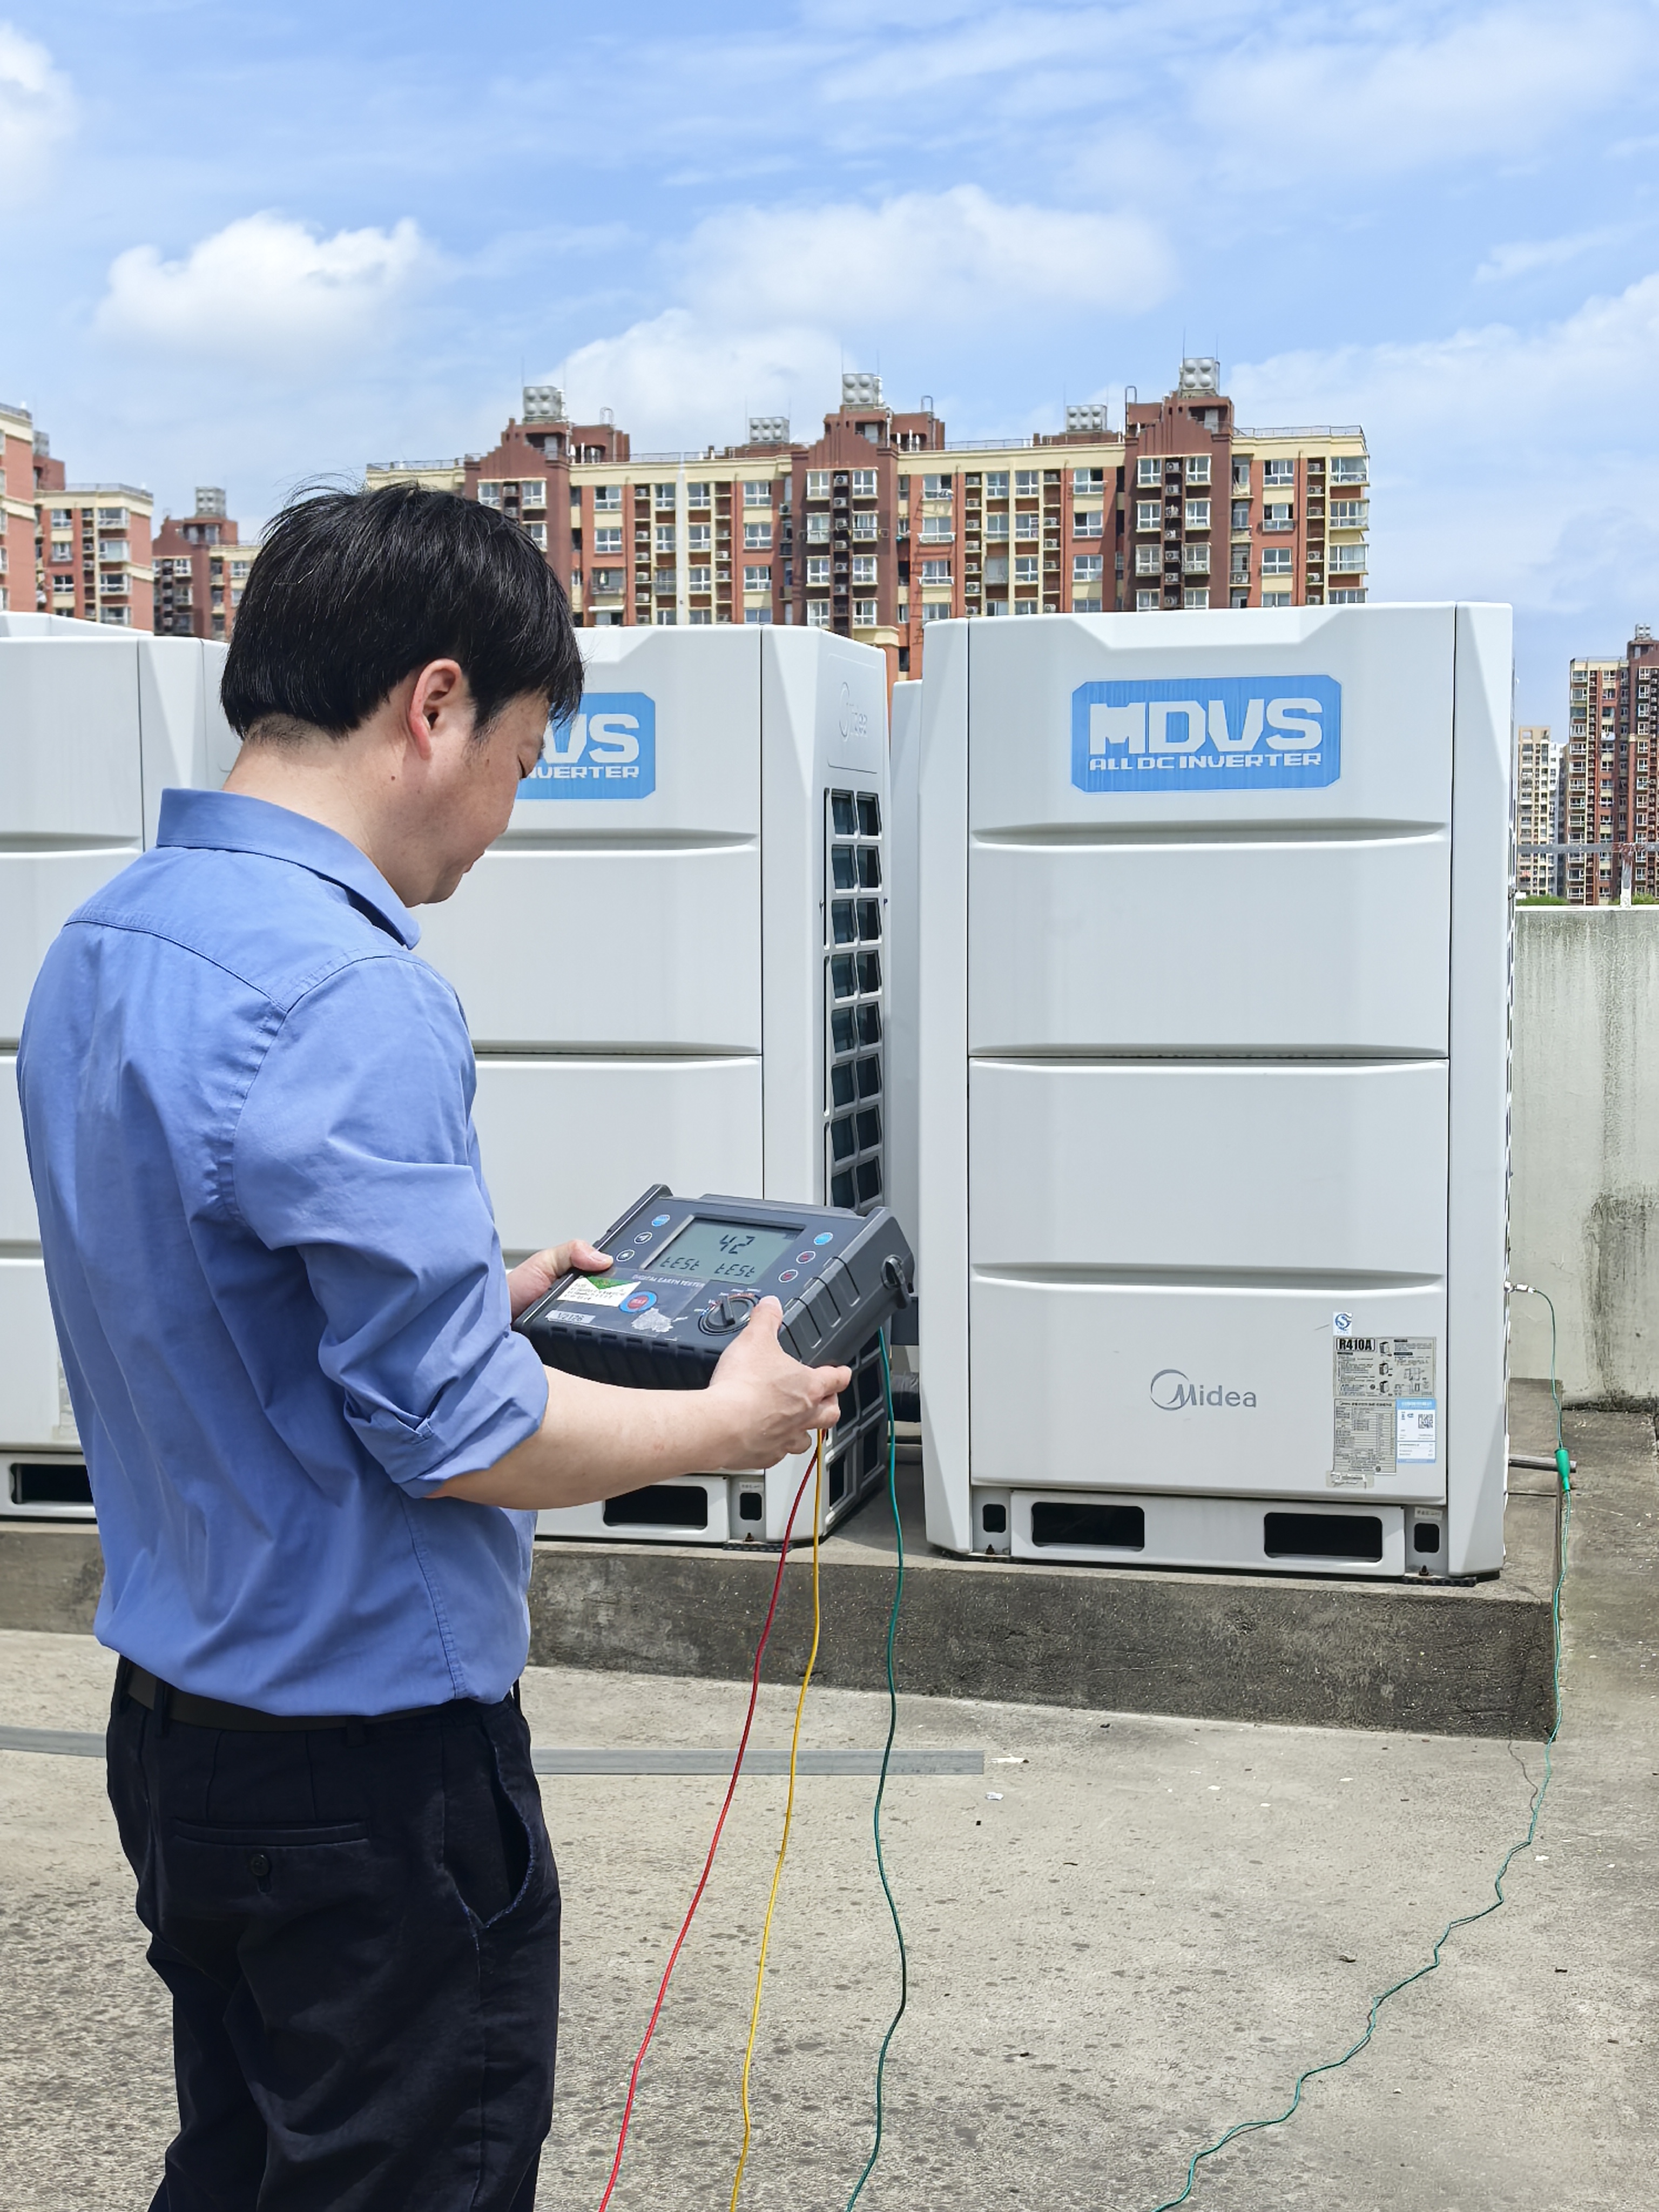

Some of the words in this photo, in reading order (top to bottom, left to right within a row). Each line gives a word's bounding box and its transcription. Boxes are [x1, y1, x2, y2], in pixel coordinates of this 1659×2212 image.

[1090, 698, 1323, 755] MDVS
[1090, 757, 1133, 771] ALL
[1137, 757, 1175, 770] DC
[1179, 753, 1321, 769] INVERTER
[1339, 1339, 1372, 1351] R410A
[1150, 1369, 1257, 1411] Midea
